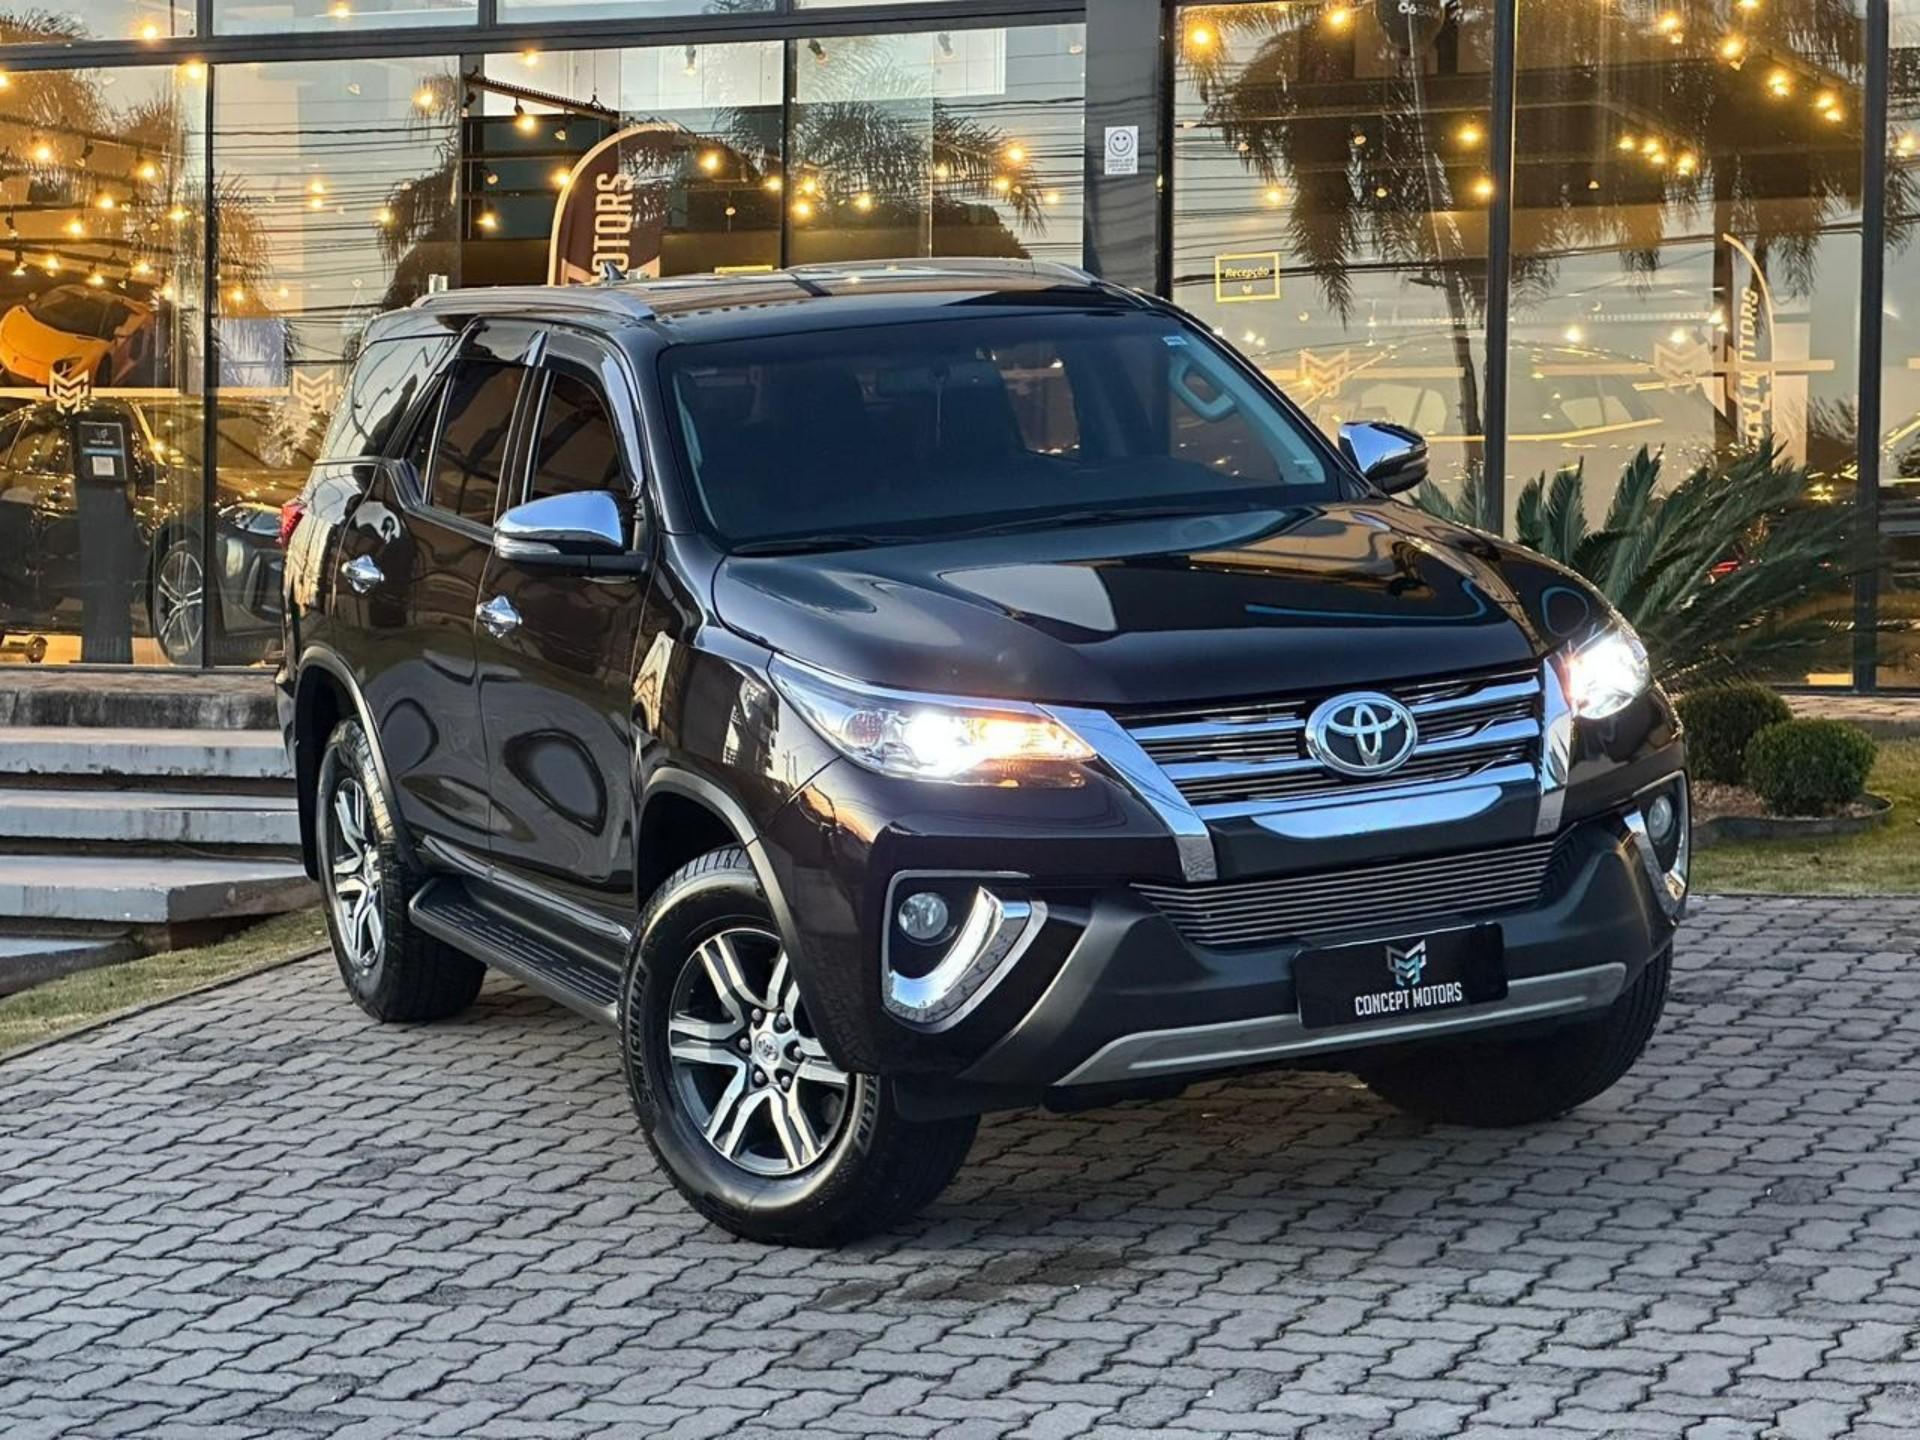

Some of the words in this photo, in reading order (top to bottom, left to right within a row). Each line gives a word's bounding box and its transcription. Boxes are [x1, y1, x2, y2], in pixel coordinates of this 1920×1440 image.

[591, 172, 634, 284] OTORS
[1355, 989, 1410, 1016] CONCEPT
[1412, 982, 1463, 1008] MOTORS
